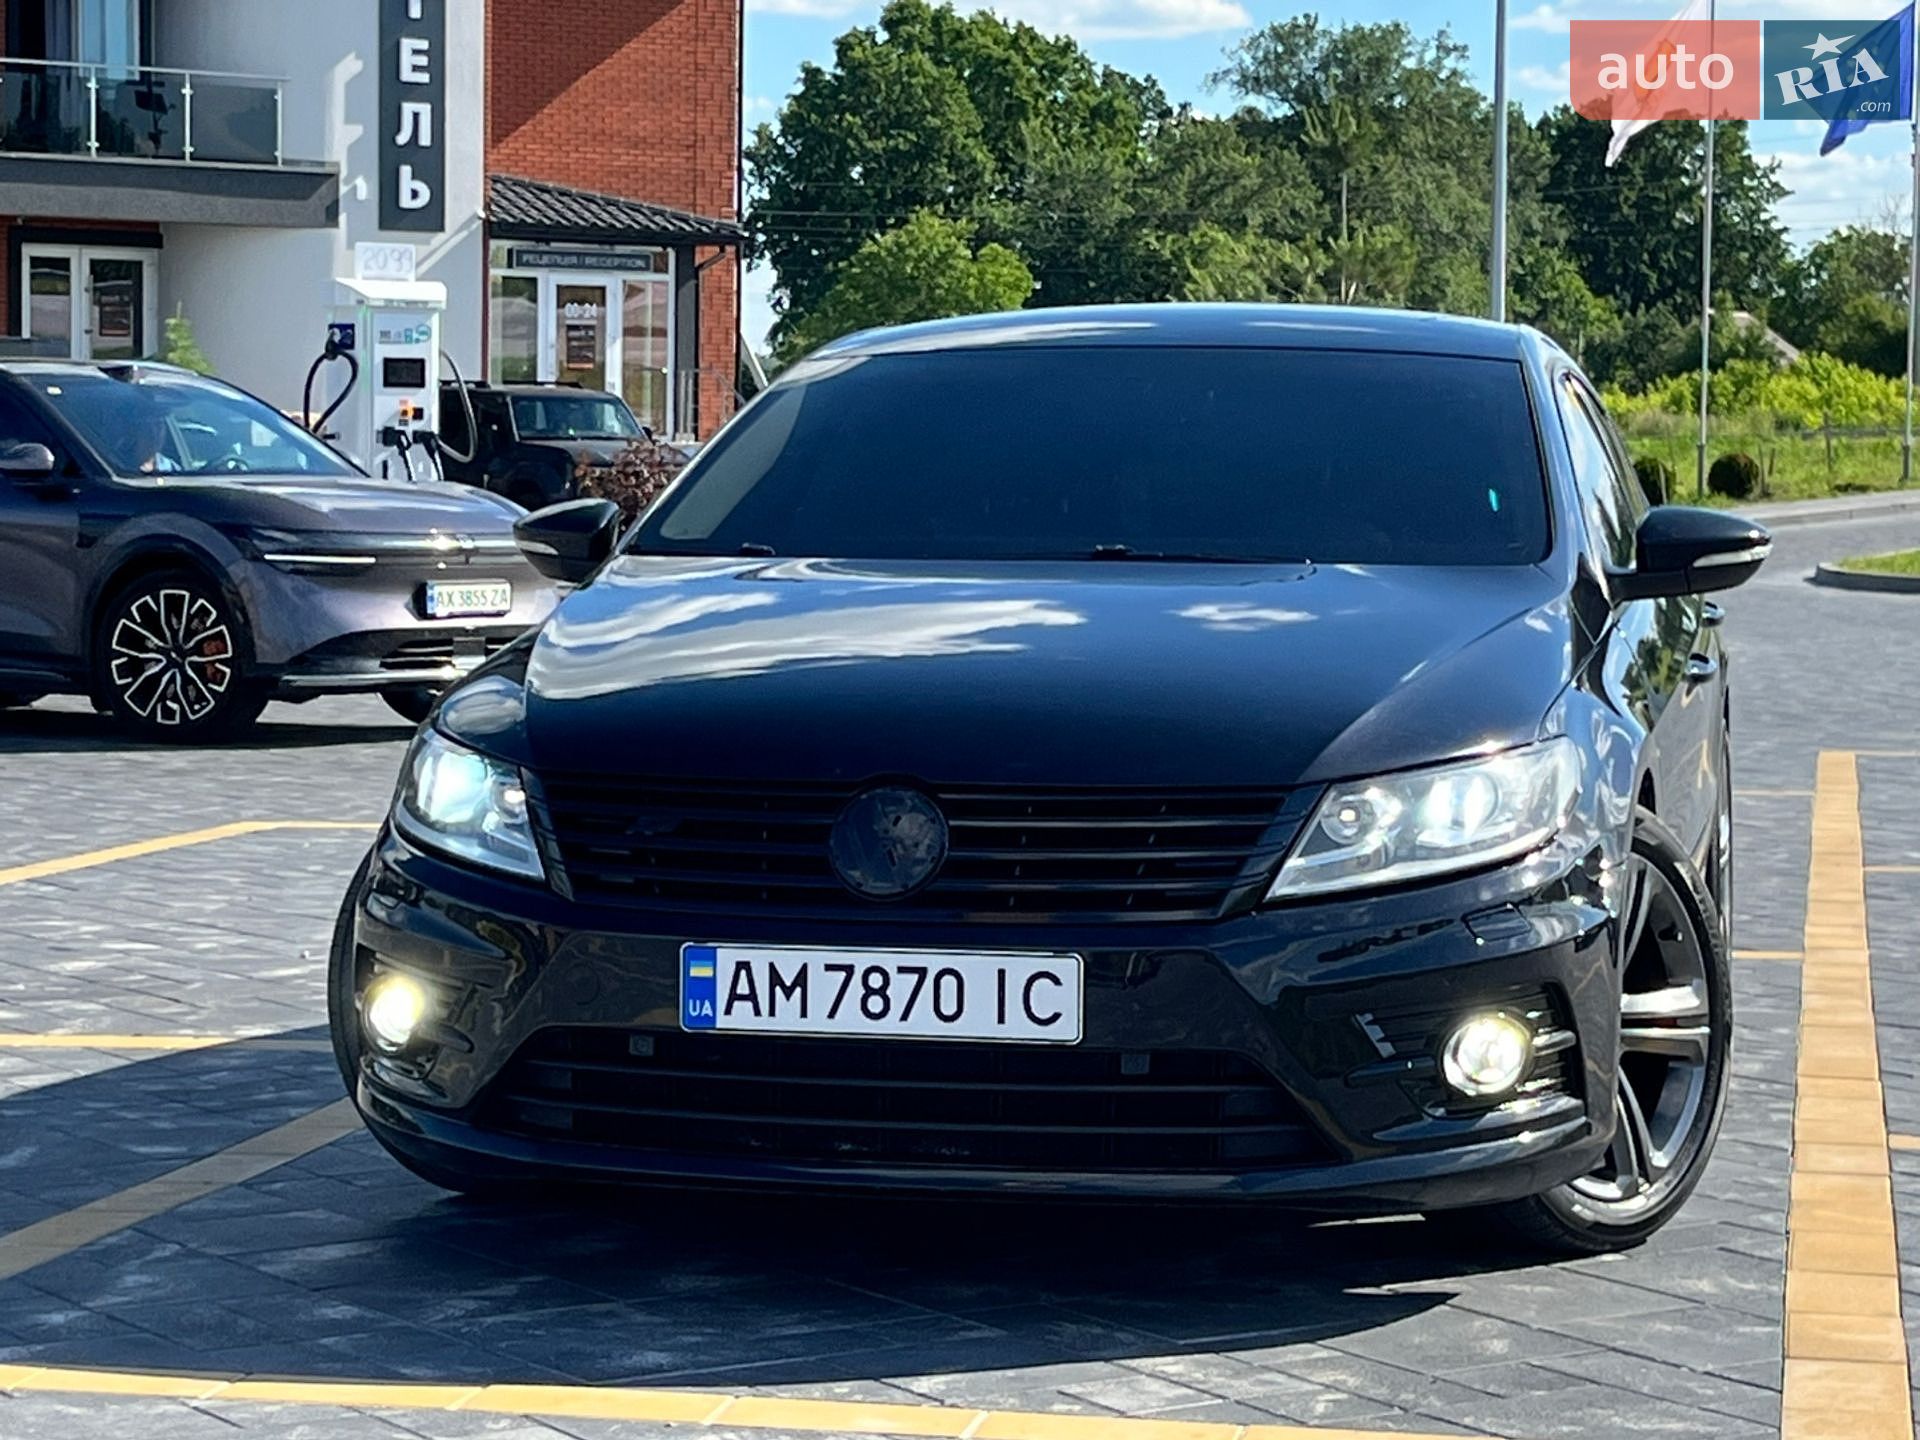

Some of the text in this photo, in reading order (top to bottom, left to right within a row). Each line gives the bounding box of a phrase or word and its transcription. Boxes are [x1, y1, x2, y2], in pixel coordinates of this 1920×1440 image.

[437, 588, 508, 608] AX 3855 ZA
[723, 960, 1063, 1027] AM 7870 IC
[688, 998, 713, 1017] UA
